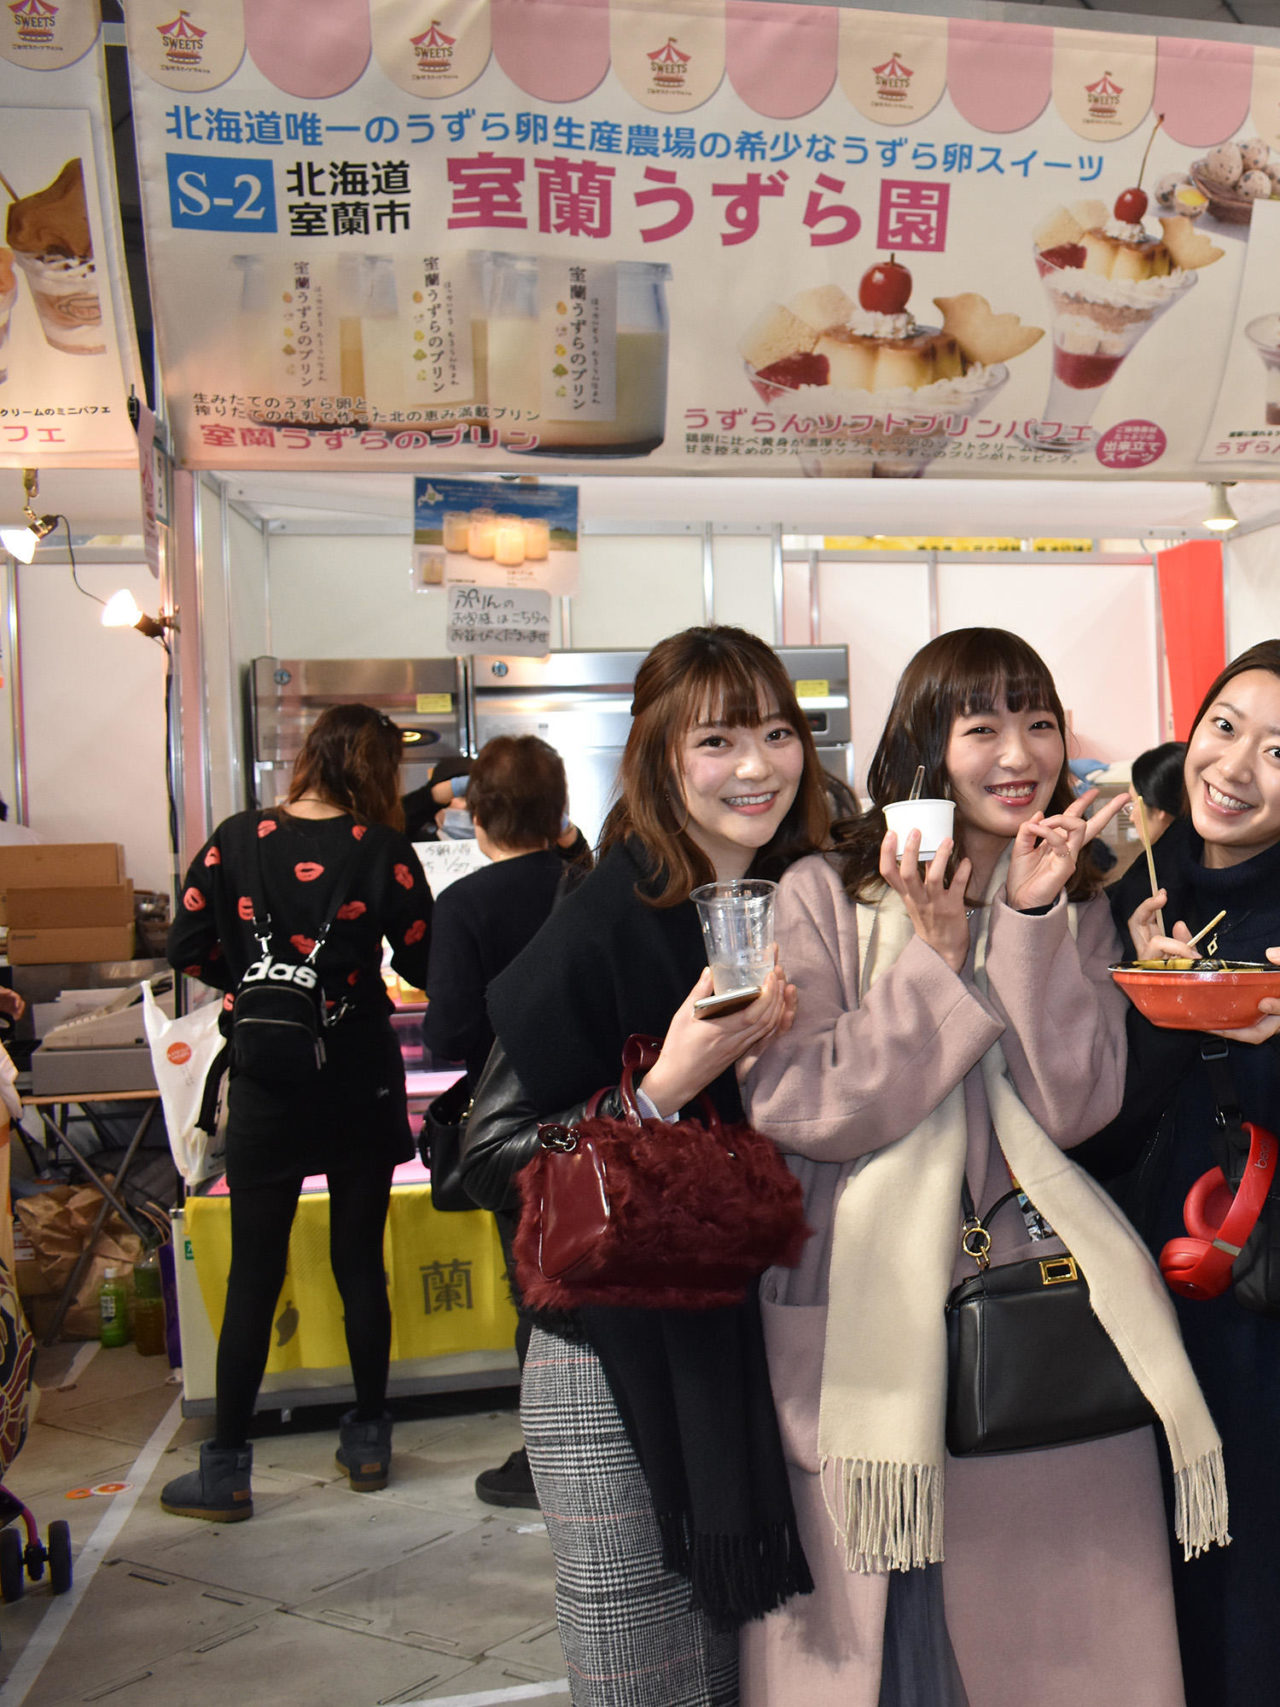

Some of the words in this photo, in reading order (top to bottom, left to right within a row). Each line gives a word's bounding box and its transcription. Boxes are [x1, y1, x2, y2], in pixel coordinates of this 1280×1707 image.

[15, 15, 55, 28] SWEETS
[162, 36, 203, 50] SWEETS
[414, 46, 453, 59] SWEETS
[650, 62, 688, 74] SWEETS
[875, 75, 910, 88] SWEETS
[1087, 93, 1120, 105] SWEETS
[165, 105, 1104, 181] 北海道唯一のうずら卵生産農場の希少なうずら卵スイーツ
[177, 171, 266, 220] S-2
[286, 160, 411, 197] 北海道
[288, 200, 411, 237] 室蘭市
[447, 151, 950, 252] 室蘭うずら園
[294, 261, 314, 388] 室蘭うずらのプリン
[423, 256, 445, 393] 室蘭うずらのプリン
[569, 266, 587, 410] 室蘭うずらのプリン
[201, 423, 541, 451] 室蘭うずらのプリン
[684, 408, 1093, 442] うずらんソフトプリンパフェ
[1102, 452, 1155, 463] スイーツ
[419, 1258, 473, 1316] 蘭
